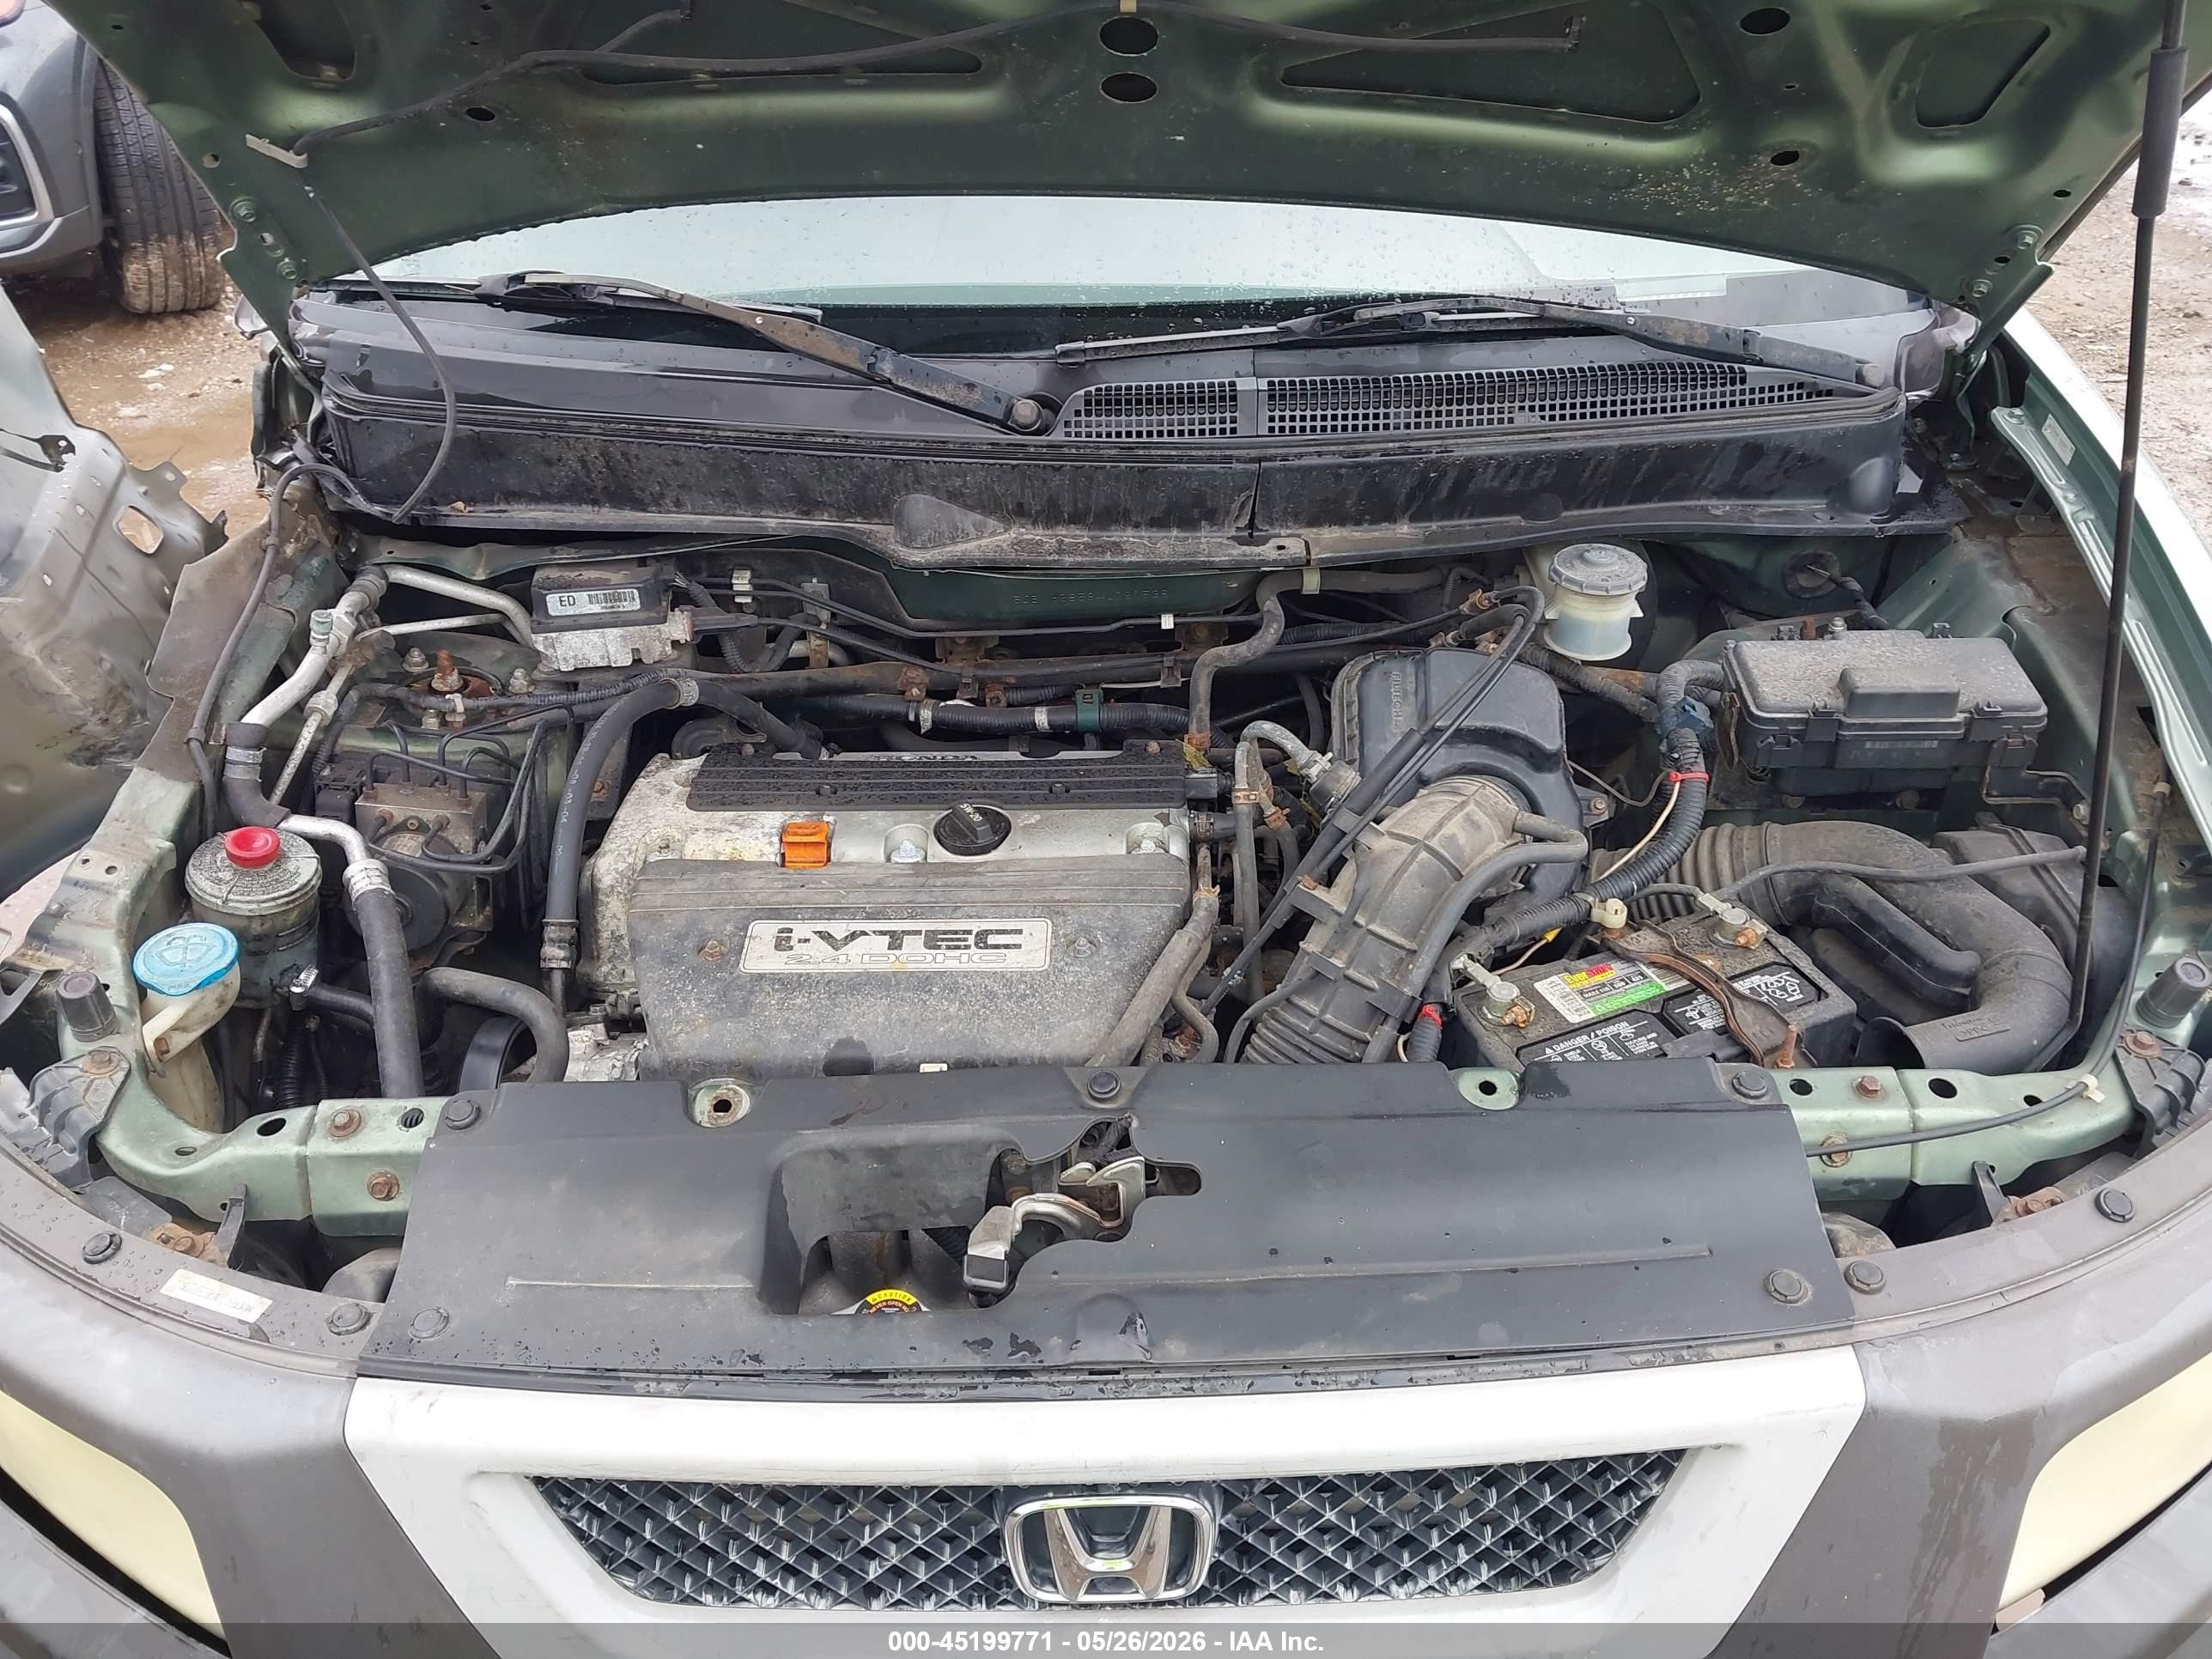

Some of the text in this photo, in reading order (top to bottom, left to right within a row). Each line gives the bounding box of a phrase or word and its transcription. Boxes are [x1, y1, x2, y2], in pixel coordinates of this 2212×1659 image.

[559, 594, 576, 608] ED
[960, 803, 983, 822] 5W-20
[774, 927, 1023, 952] i-VTEC
[785, 952, 1006, 965] 2.4 DOHC
[1553, 1034, 1590, 1052] DANGER
[1595, 1021, 1630, 1036] POISON
[878, 1291, 912, 1303] CAUTION
[870, 1301, 887, 1314] NEVER
